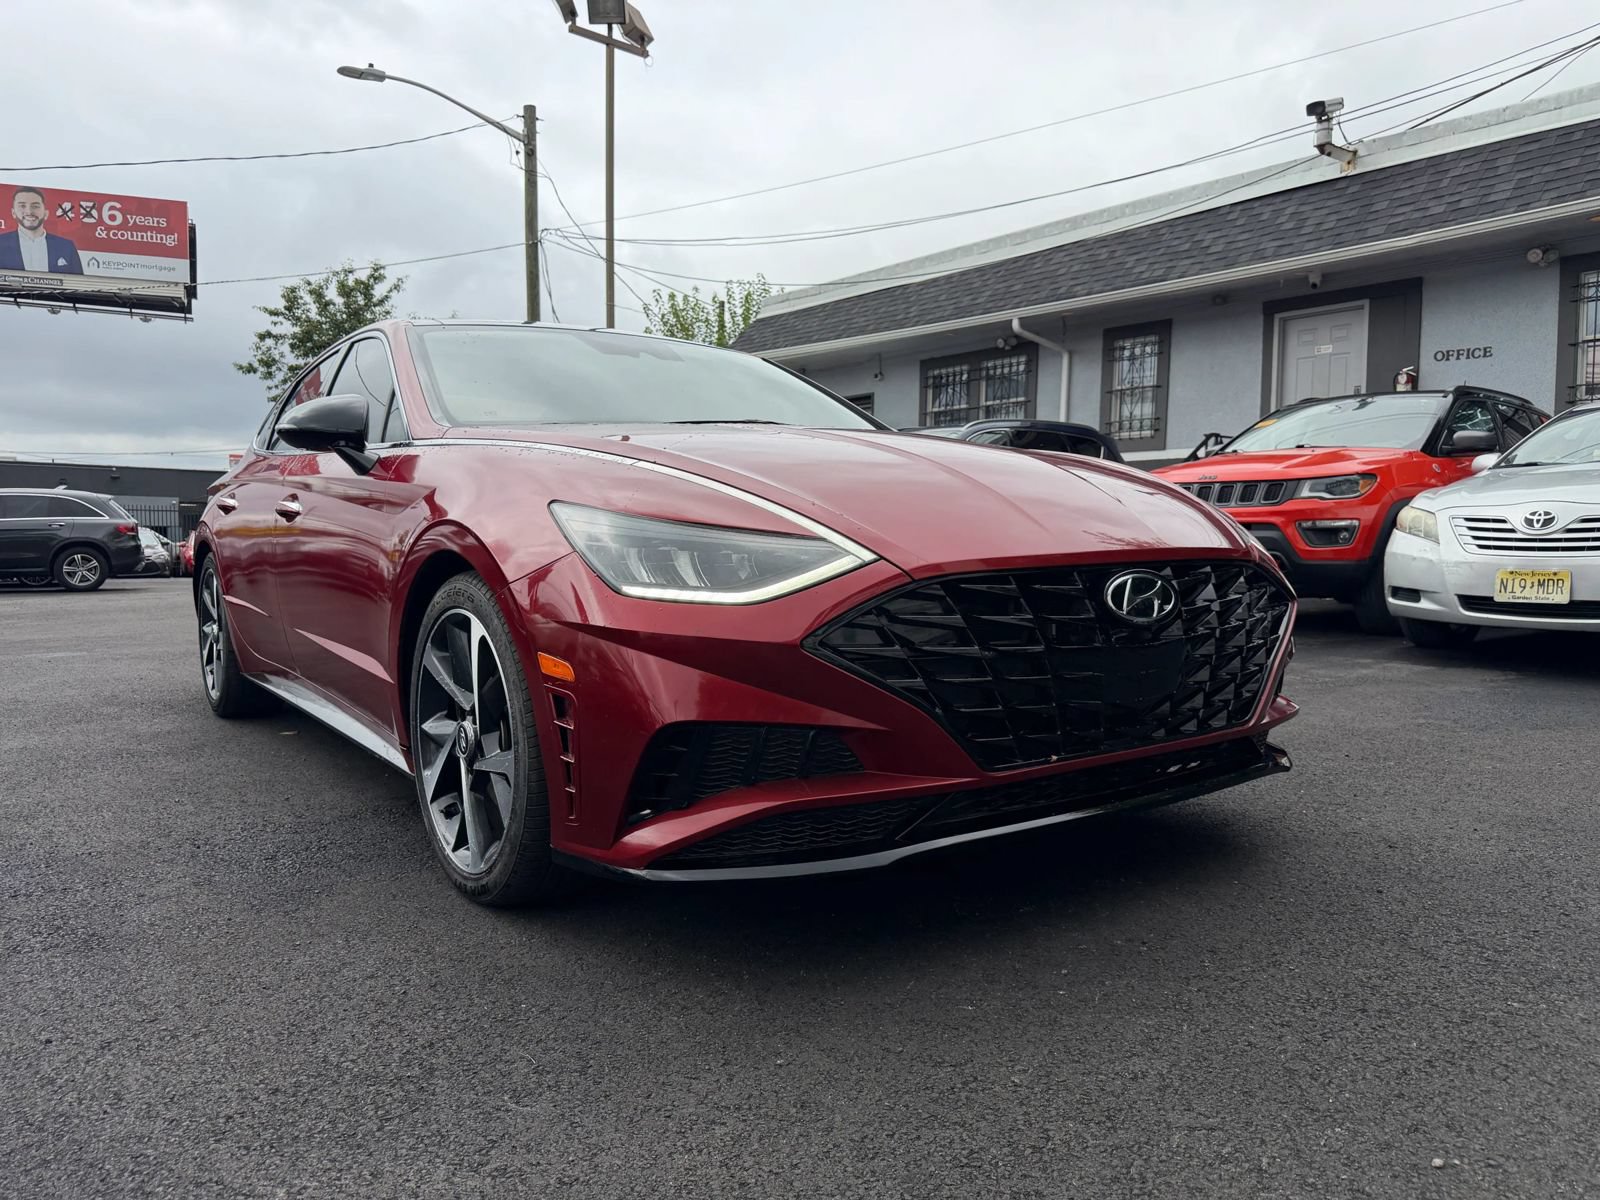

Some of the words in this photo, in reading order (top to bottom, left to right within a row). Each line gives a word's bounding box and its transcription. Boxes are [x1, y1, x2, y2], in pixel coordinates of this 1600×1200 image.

[102, 201, 123, 226] 6
[127, 213, 167, 228] years
[95, 226, 108, 239] &
[110, 229, 178, 247] counting!
[28, 277, 62, 286] CHANNEL
[1433, 346, 1493, 362] OFFICE
[1499, 578, 1527, 594] N19
[1536, 578, 1565, 595] MDR
